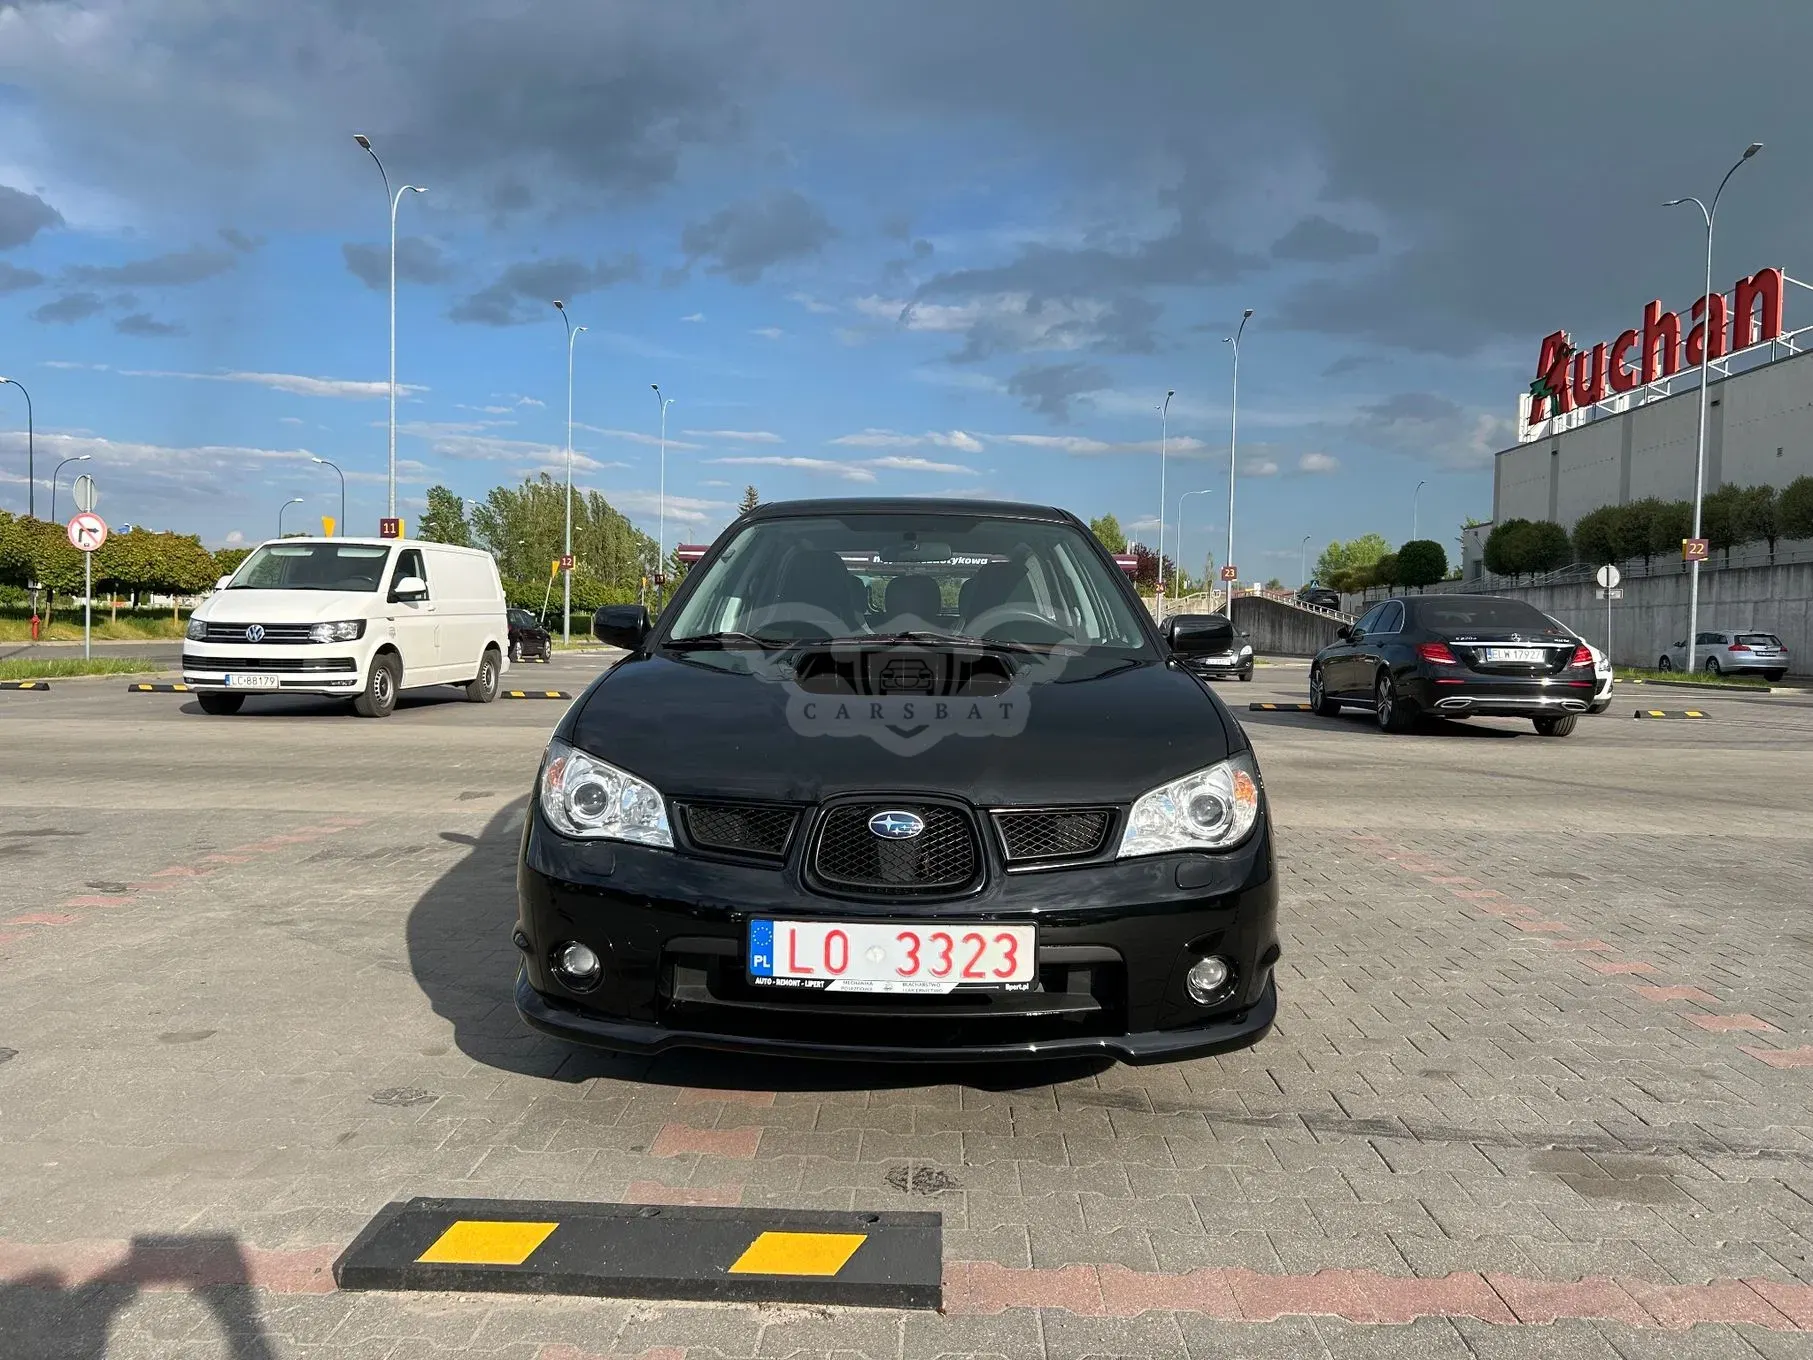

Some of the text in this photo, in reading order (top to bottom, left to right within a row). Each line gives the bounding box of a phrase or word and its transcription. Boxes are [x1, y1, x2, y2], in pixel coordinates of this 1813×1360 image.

[1528, 267, 1784, 426] Auchan
[383, 522, 396, 534] 11
[1689, 543, 1705, 555] 22
[562, 557, 572, 566] 12
[1224, 568, 1235, 577] 23
[1492, 649, 1540, 660] ELW 17927
[231, 676, 275, 686] LC 88179
[895, 931, 1018, 979] 3323
[753, 955, 771, 968] PL
[755, 977, 772, 985] AUTO
[776, 978, 800, 987] REMONT
